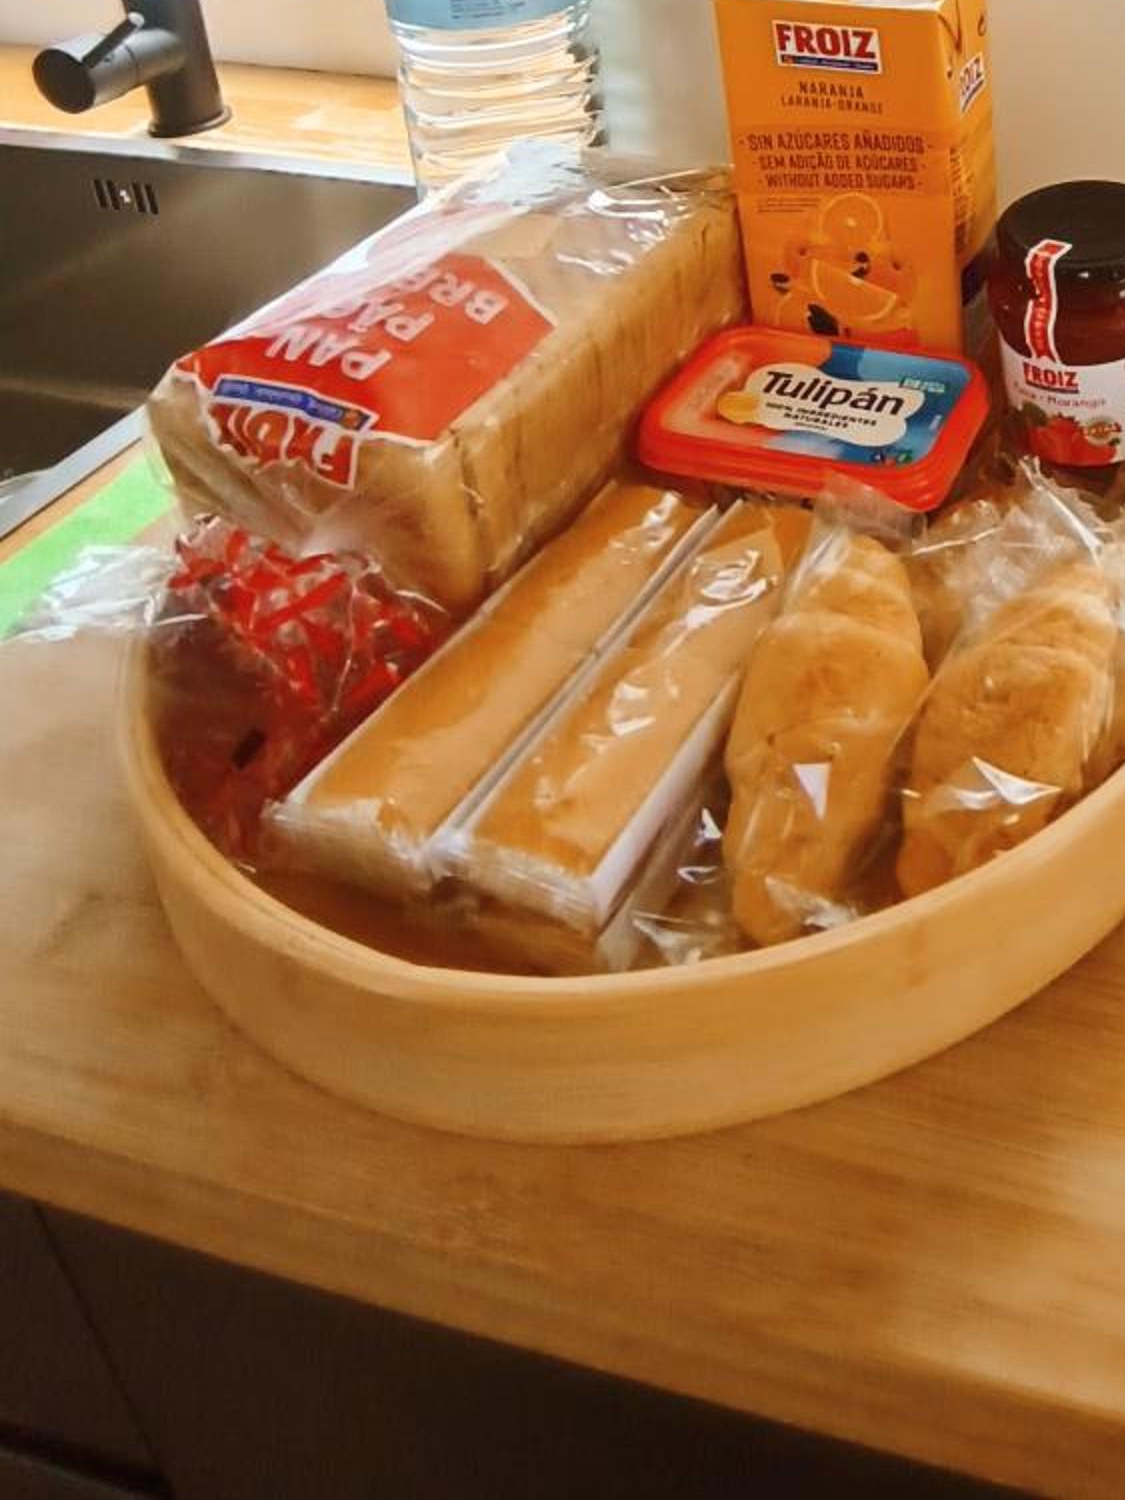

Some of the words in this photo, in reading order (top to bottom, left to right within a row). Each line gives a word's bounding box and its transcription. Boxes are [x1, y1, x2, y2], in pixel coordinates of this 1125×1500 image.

[775, 23, 876, 60] FROIZ
[800, 80, 864, 99] NARANJA
[748, 133, 773, 150] SIN
[777, 129, 849, 150] AZÚCARES
[854, 130, 926, 154] AÑADIDOS
[760, 154, 785, 170] SEM
[789, 151, 834, 173] ADIÇÃO
[838, 156, 852, 169] DE
[766, 174, 820, 189] WITHOUT
[824, 174, 864, 189] ADDED
[866, 174, 916, 190] SUGARS
[264, 324, 393, 381] PAN
[1023, 361, 1079, 389] FROIZ
[762, 371, 905, 416] Tulipán
[782, 411, 850, 430] NATURALES
[797, 407, 878, 427] INGREDIENTES
